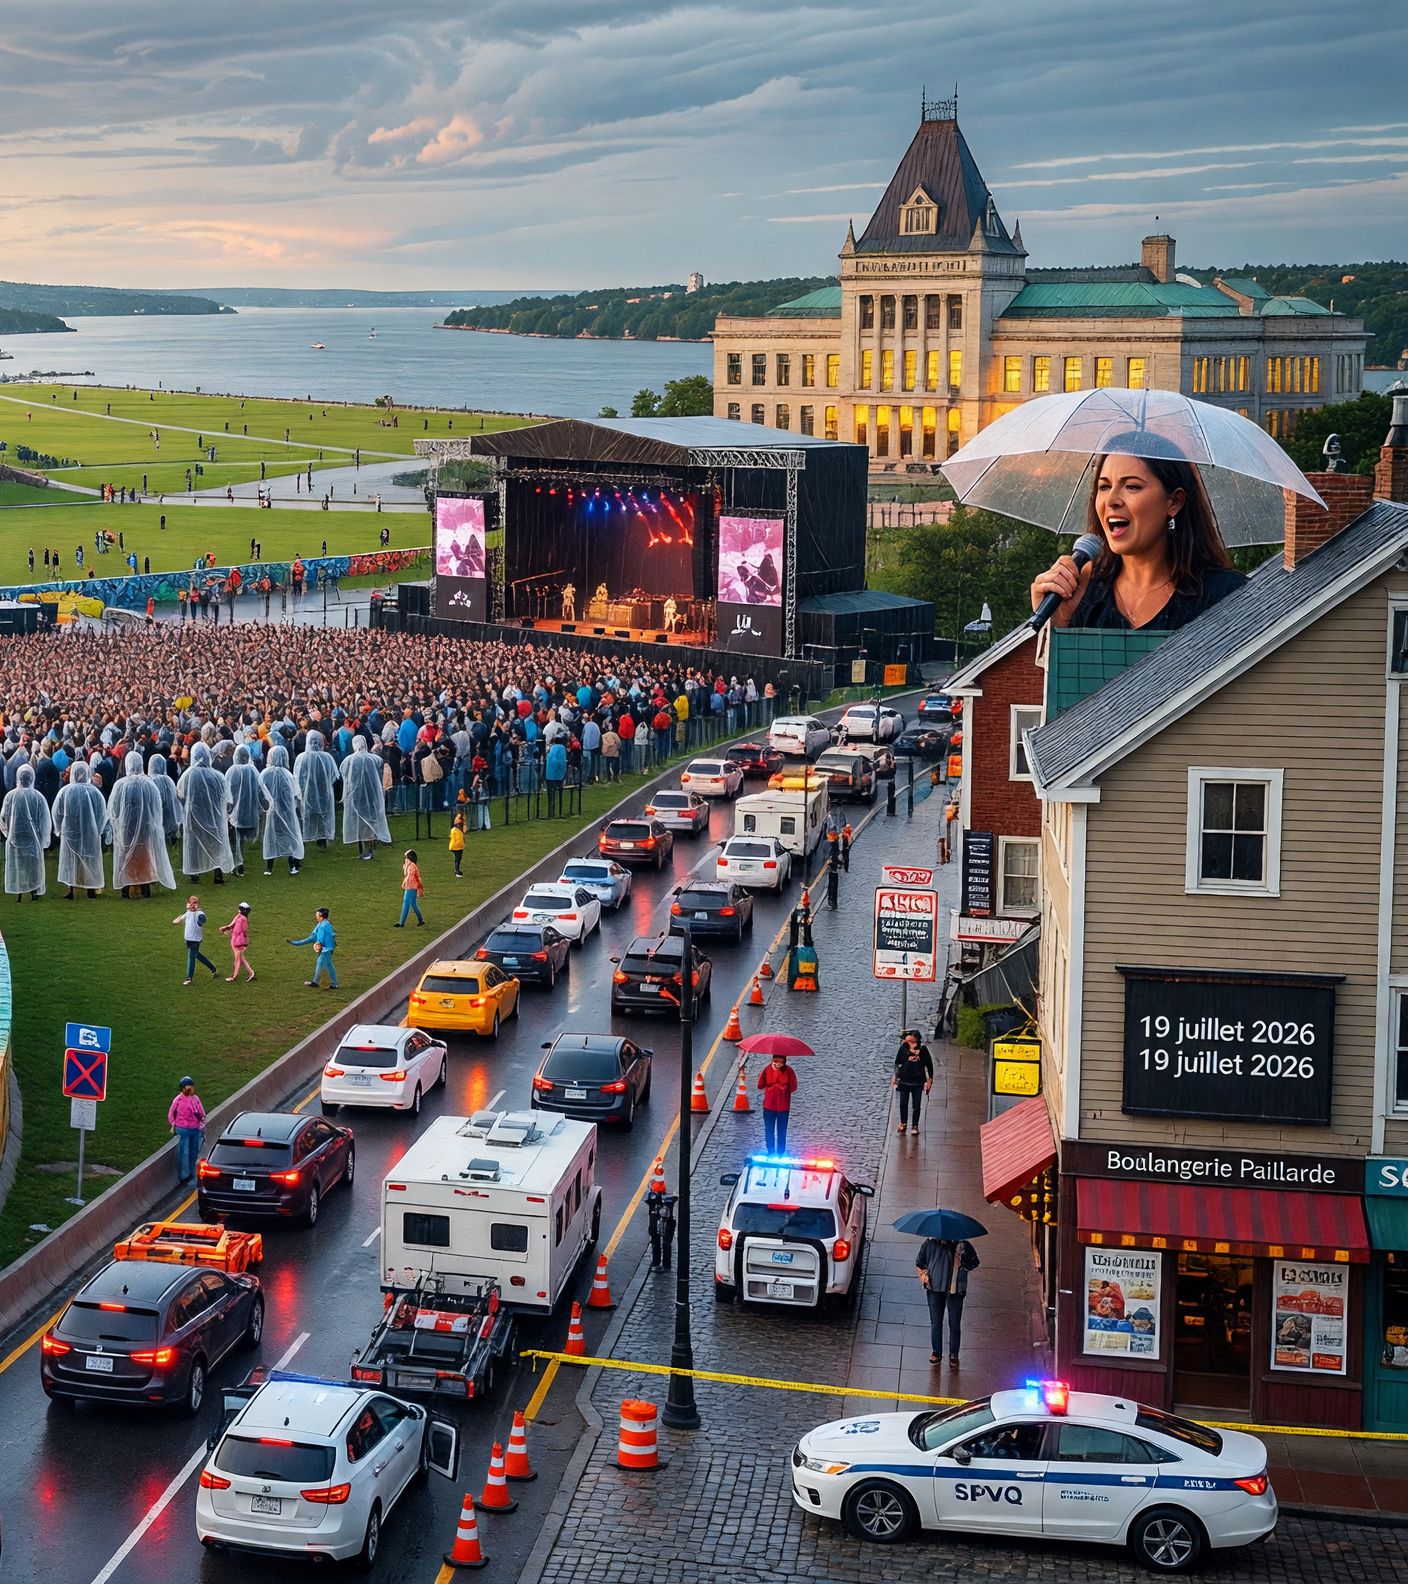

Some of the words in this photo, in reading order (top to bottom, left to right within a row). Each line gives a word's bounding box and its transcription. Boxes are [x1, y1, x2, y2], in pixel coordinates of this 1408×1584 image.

[1139, 1015, 1170, 1038] 19
[1174, 1017, 1245, 1045] juillet
[1251, 1020, 1316, 1046] 2026
[1139, 1048, 1170, 1071] 19
[1173, 1050, 1244, 1078] juillet
[1250, 1053, 1315, 1079] 2026
[1107, 1150, 1233, 1179] Boulangerie
[1240, 1158, 1336, 1184] Paillarde
[954, 1482, 1023, 1506] SPVQ
